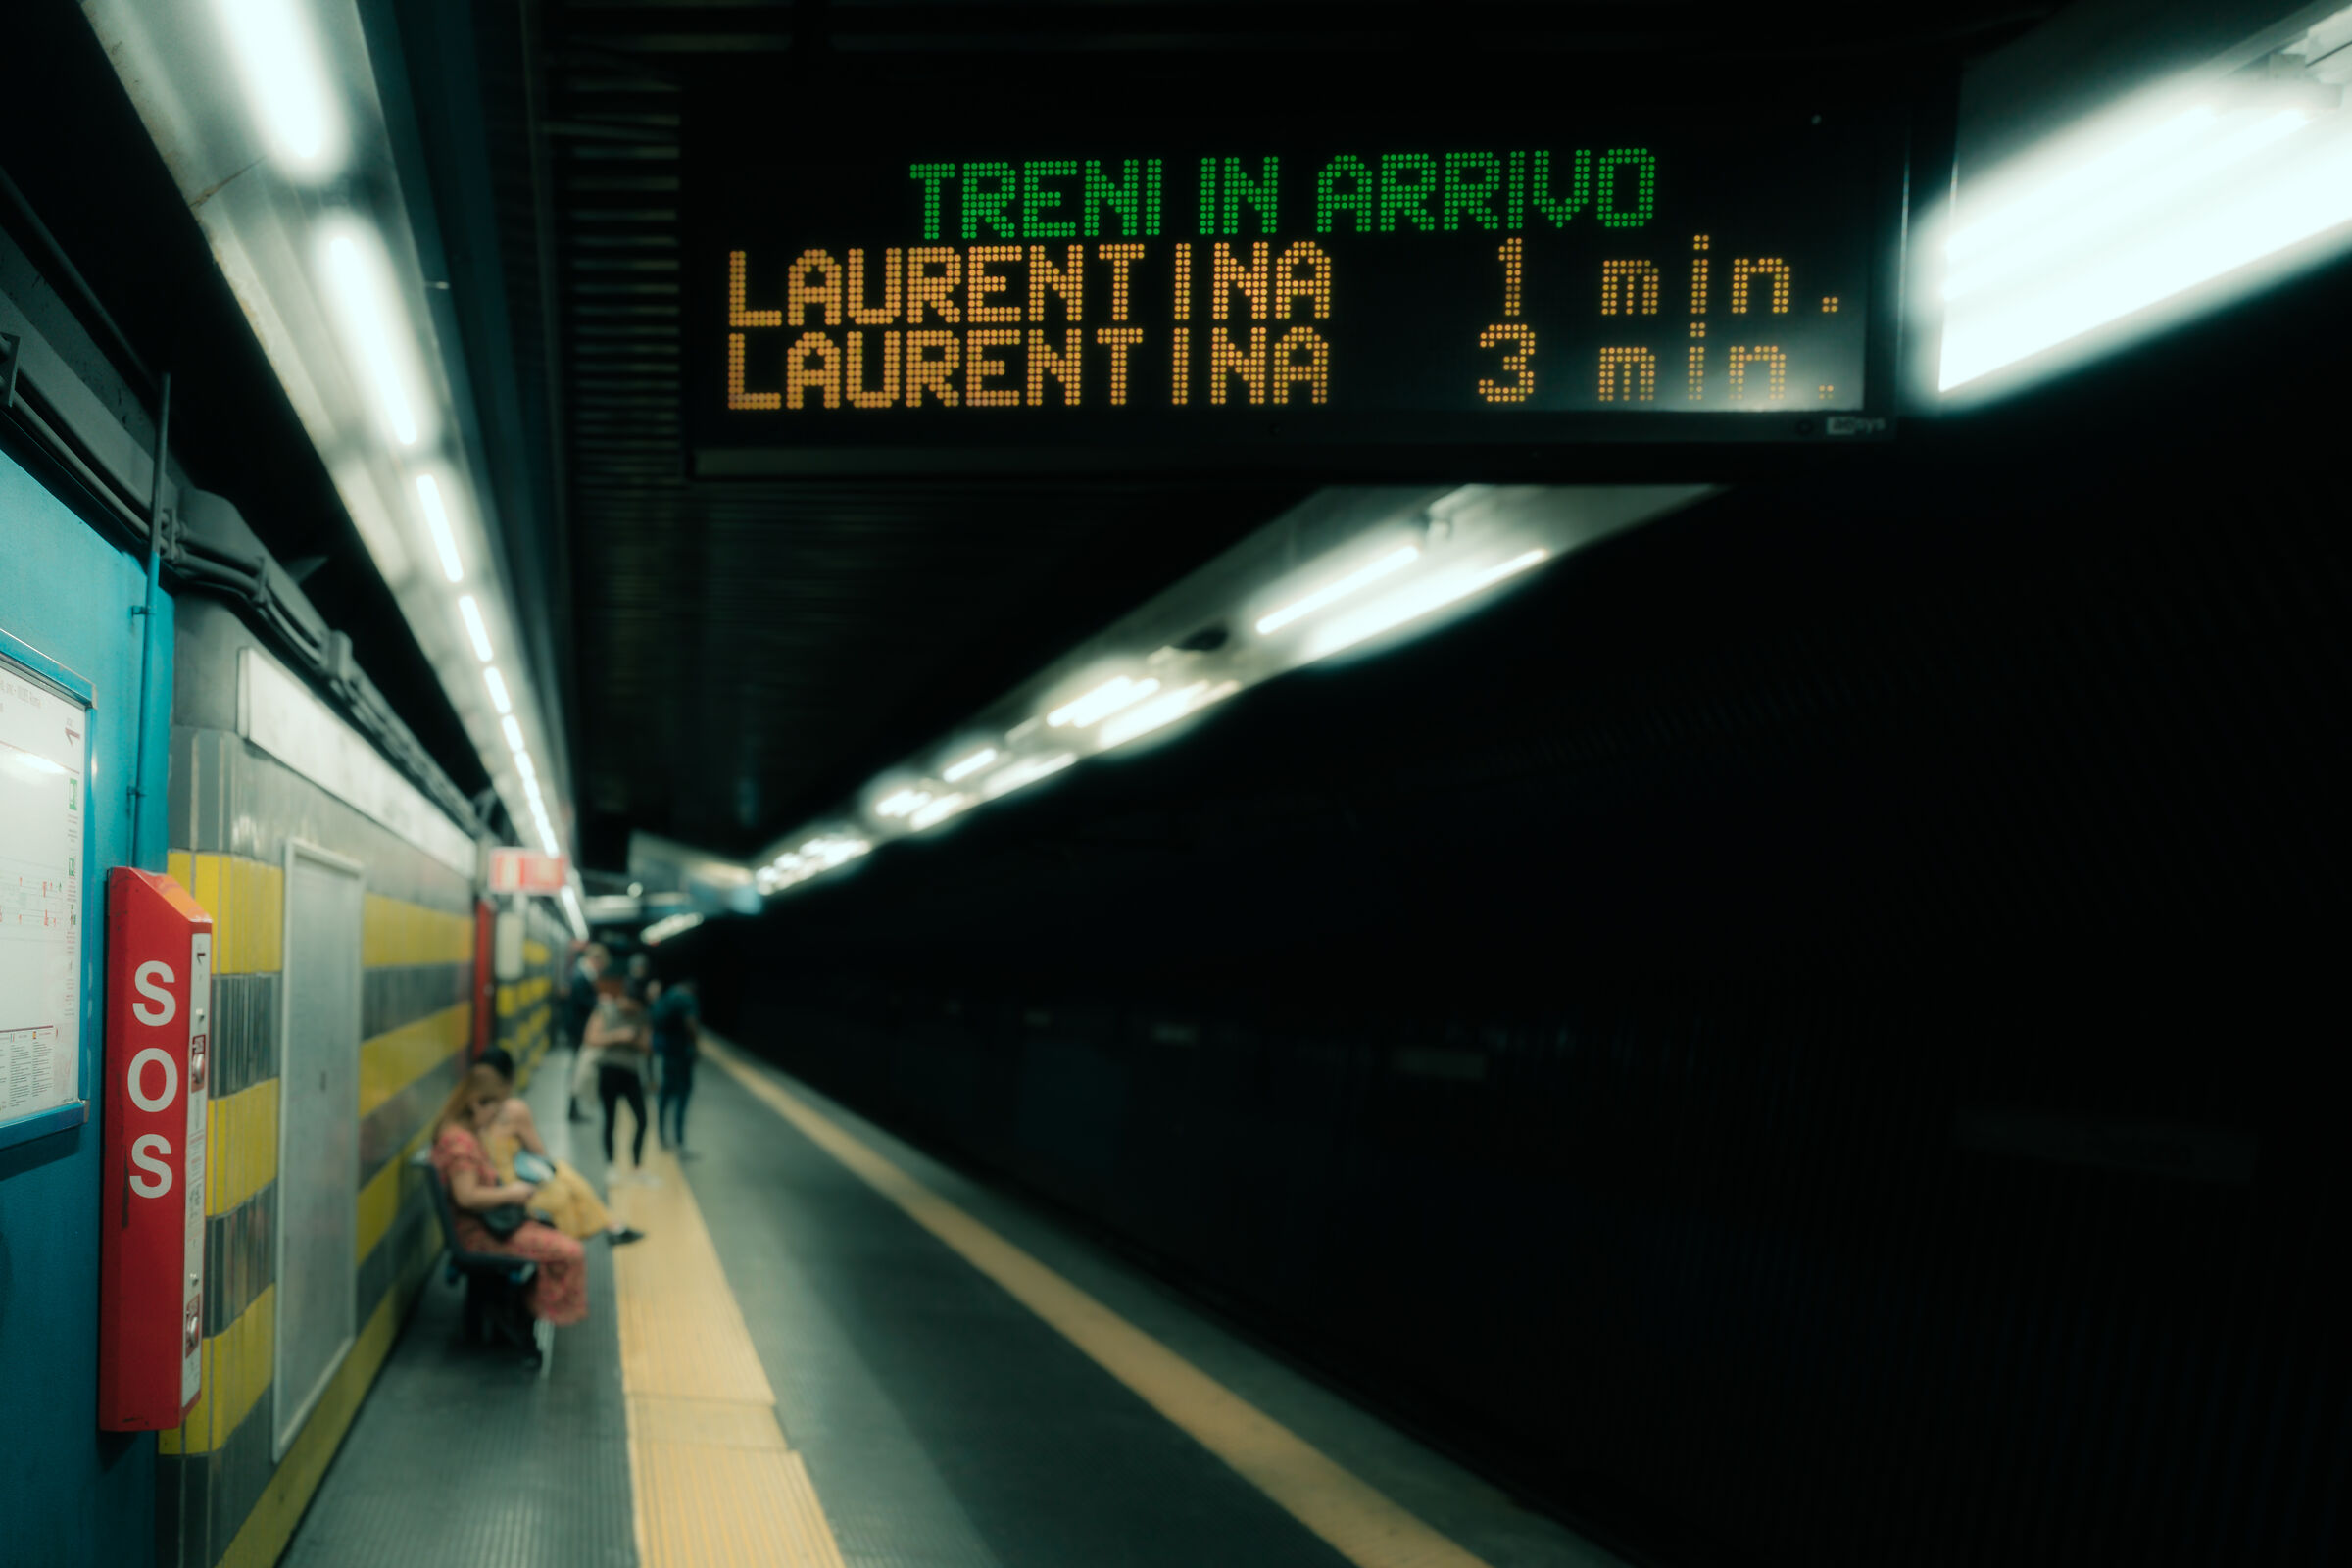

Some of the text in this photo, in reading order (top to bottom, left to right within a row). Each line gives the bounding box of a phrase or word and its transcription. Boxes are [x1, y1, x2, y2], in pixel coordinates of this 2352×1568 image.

[909, 148, 1656, 240] TRENI IN ARRIVO
[729, 234, 1838, 326] LAURENTINA 1 min.
[728, 322, 1835, 410] LAURENTINA 3 min.
[127, 960, 178, 1198] SOS
